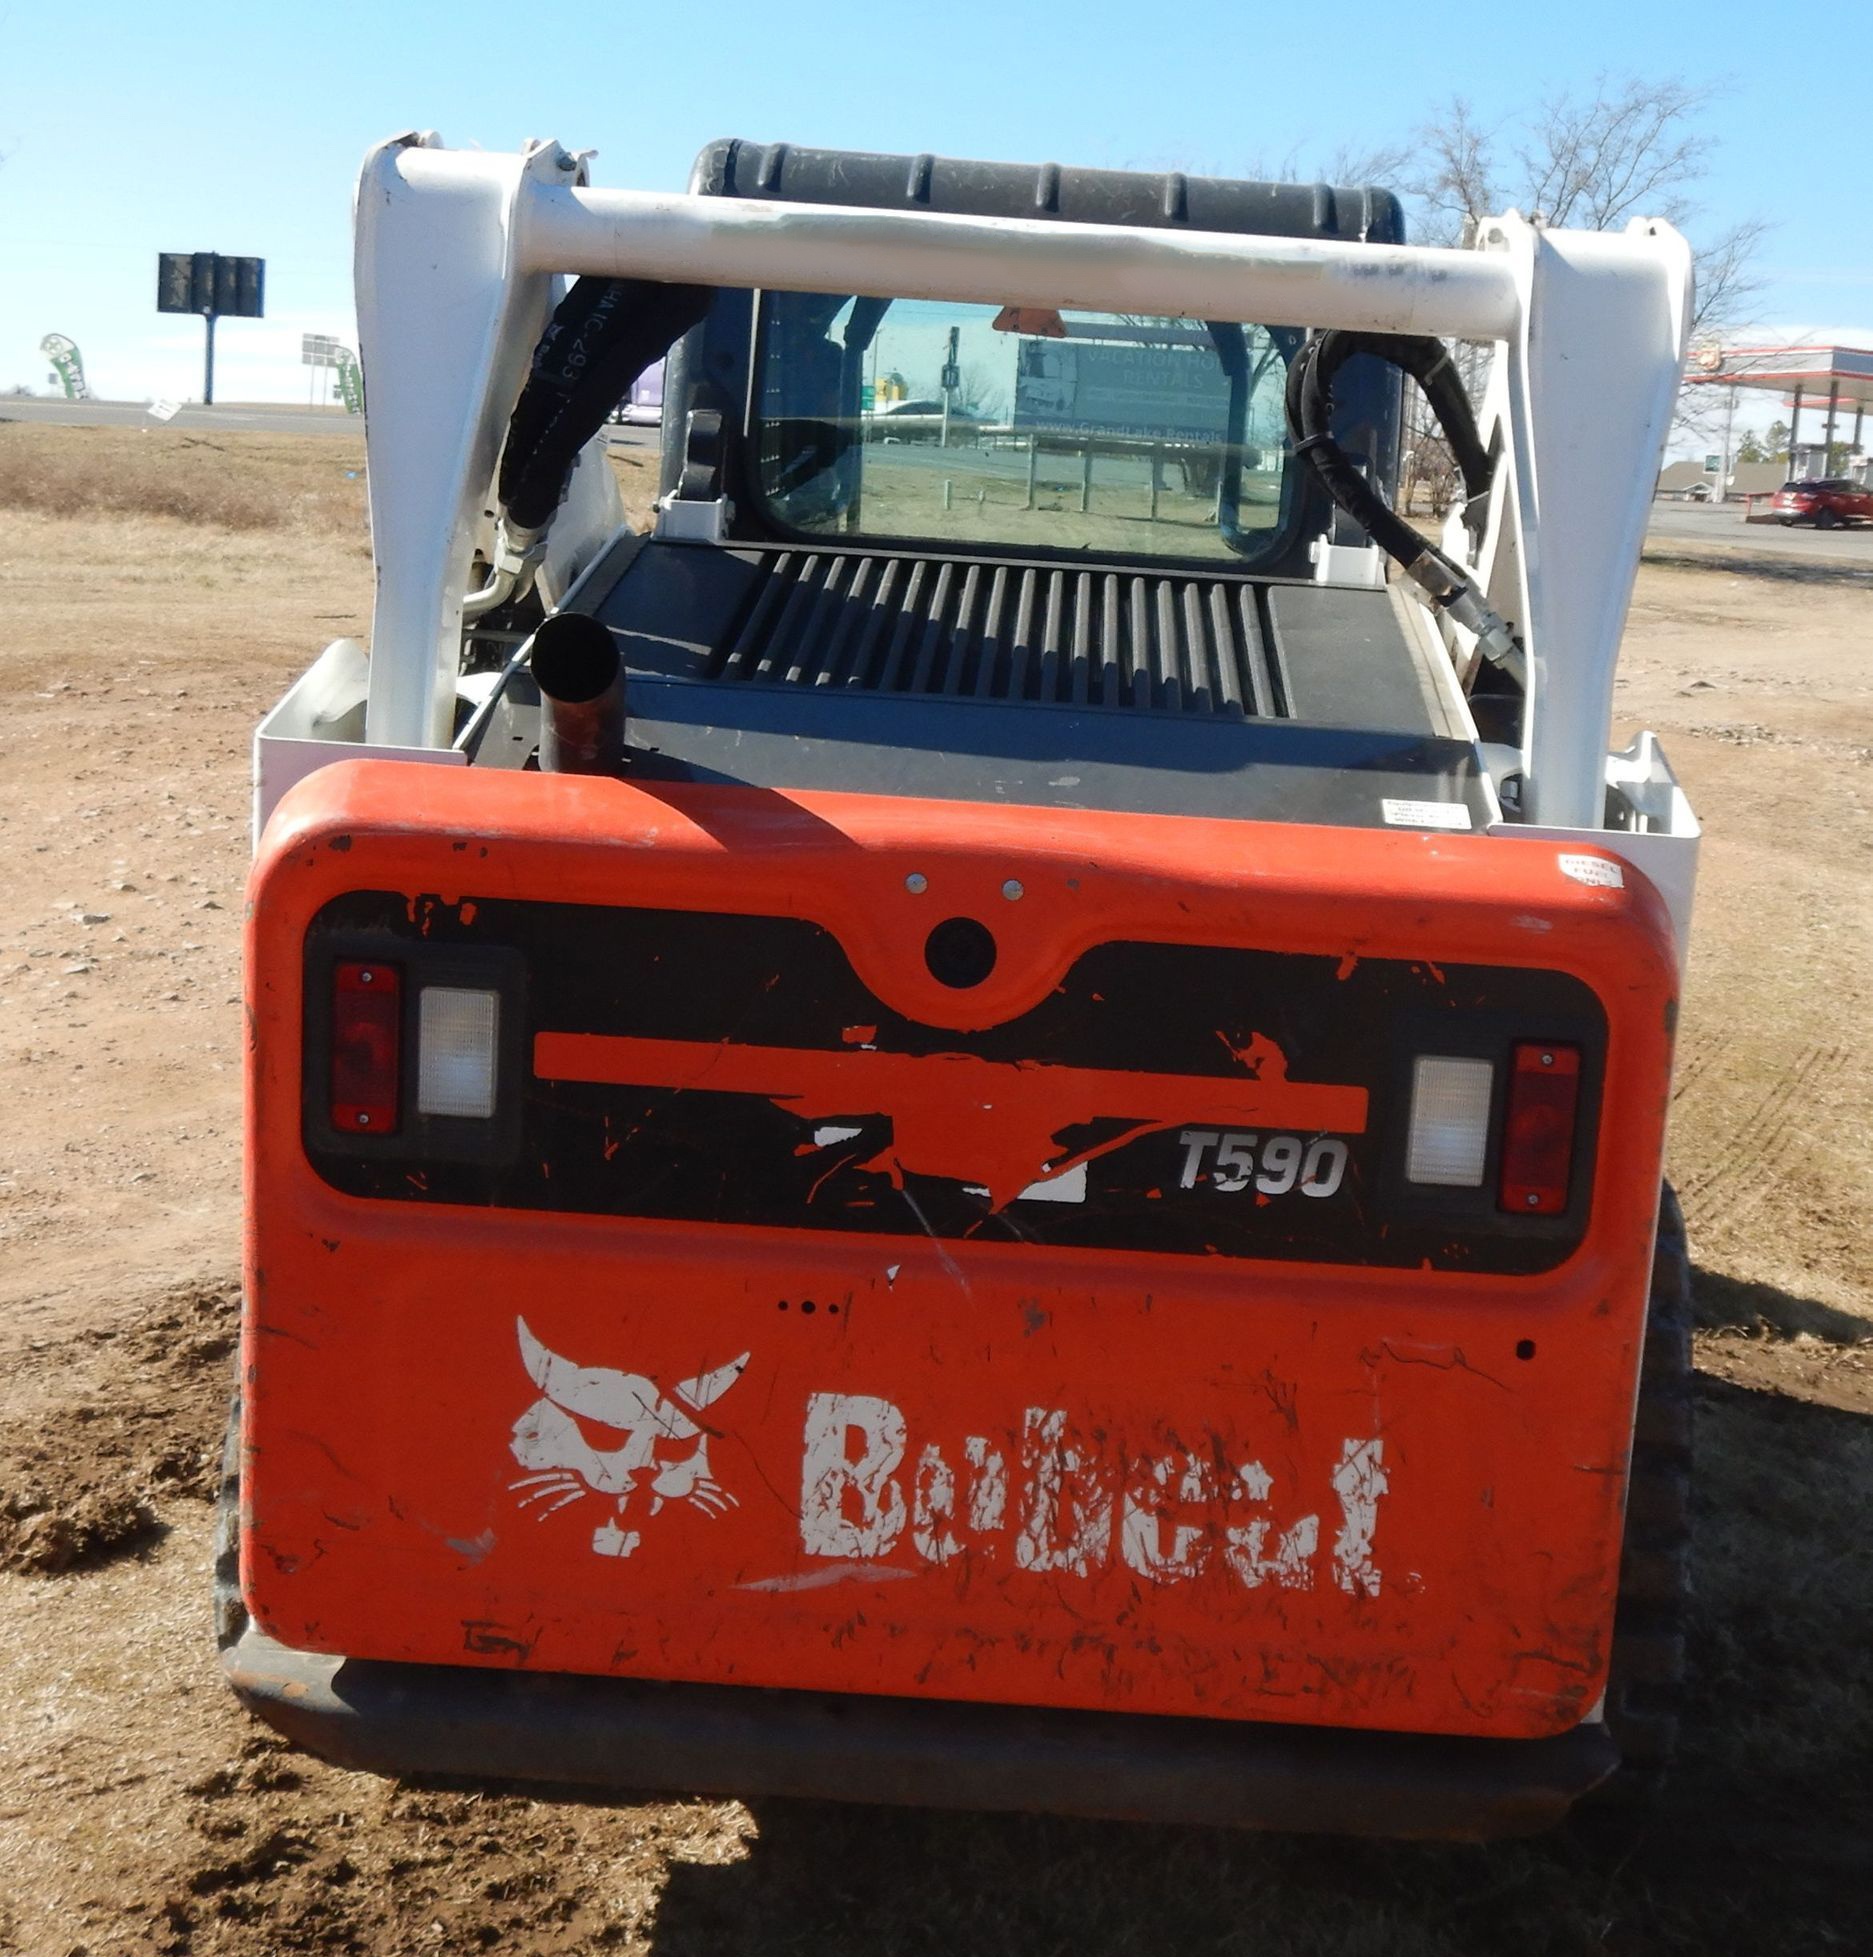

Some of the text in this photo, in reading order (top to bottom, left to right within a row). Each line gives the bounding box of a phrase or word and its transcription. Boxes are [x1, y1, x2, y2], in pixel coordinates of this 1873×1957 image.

[1088, 350, 1221, 371] VACATION HO
[1122, 369, 1204, 389] RENTALS
[1178, 1130, 1348, 1198] T590
